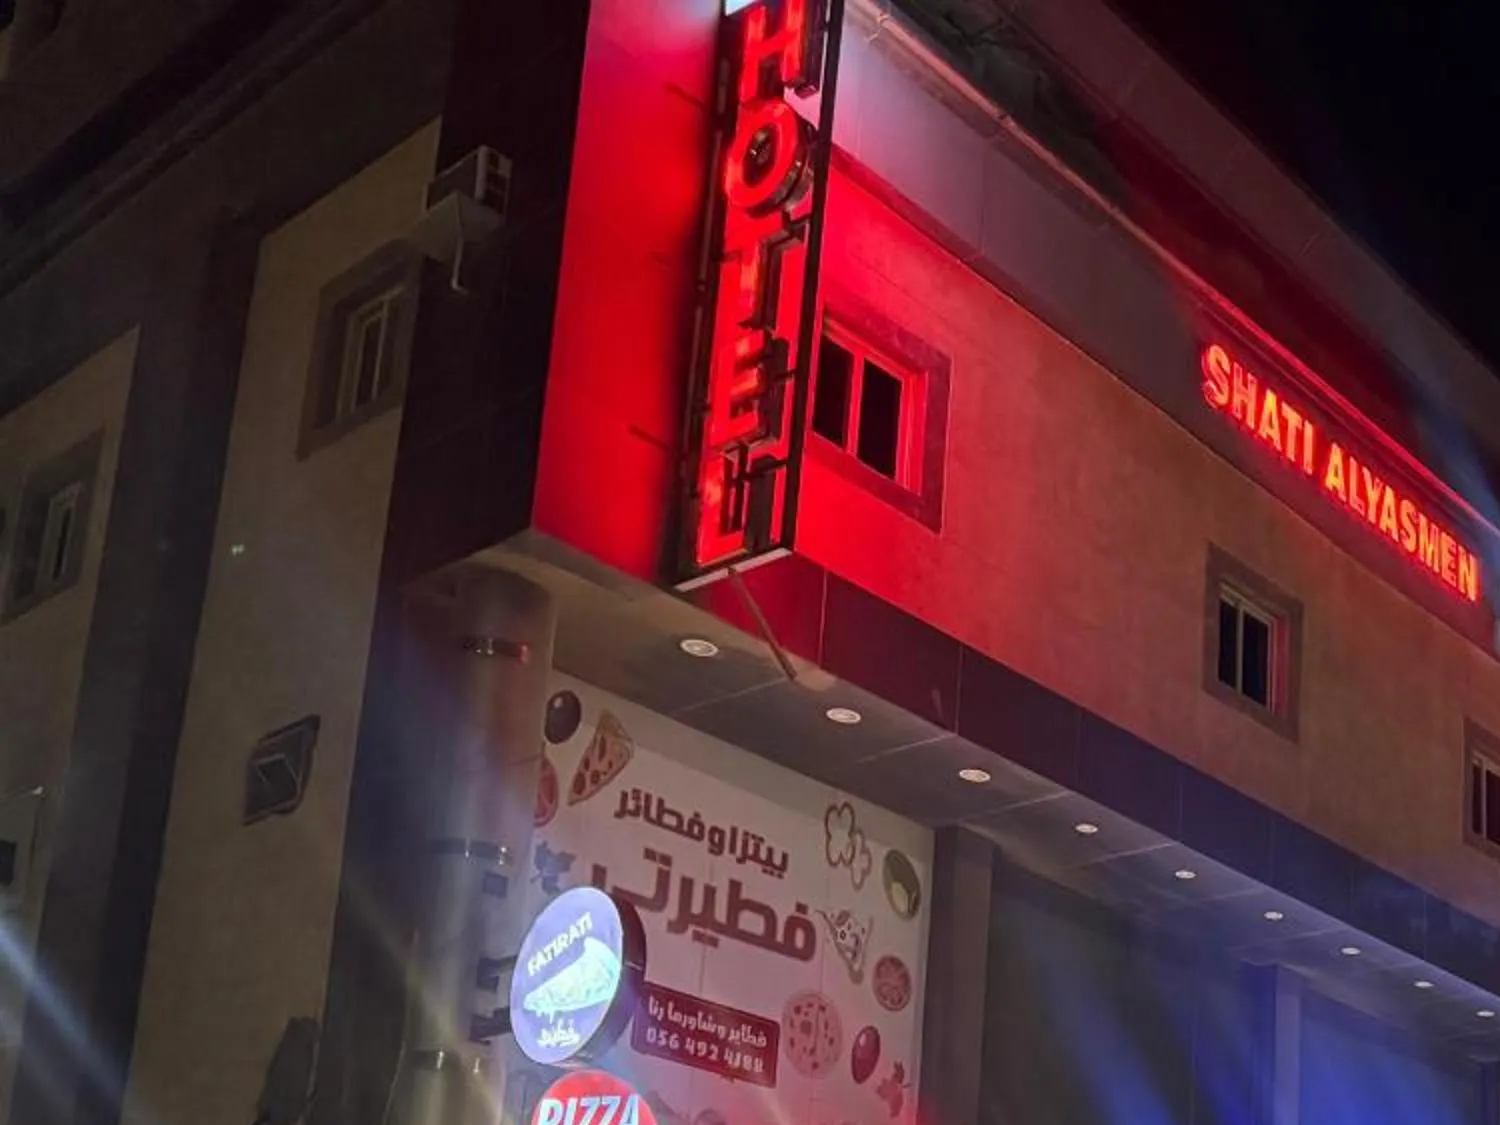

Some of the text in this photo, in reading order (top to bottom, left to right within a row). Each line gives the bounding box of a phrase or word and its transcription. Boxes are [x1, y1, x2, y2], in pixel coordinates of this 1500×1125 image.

[697, 0, 810, 565] HOTEL
[1202, 344, 1481, 602] SHATI ALYASMEN
[527, 911, 593, 977] FATIRATI
[646, 1027, 680, 1050] 056
[685, 1037, 719, 1061] 492
